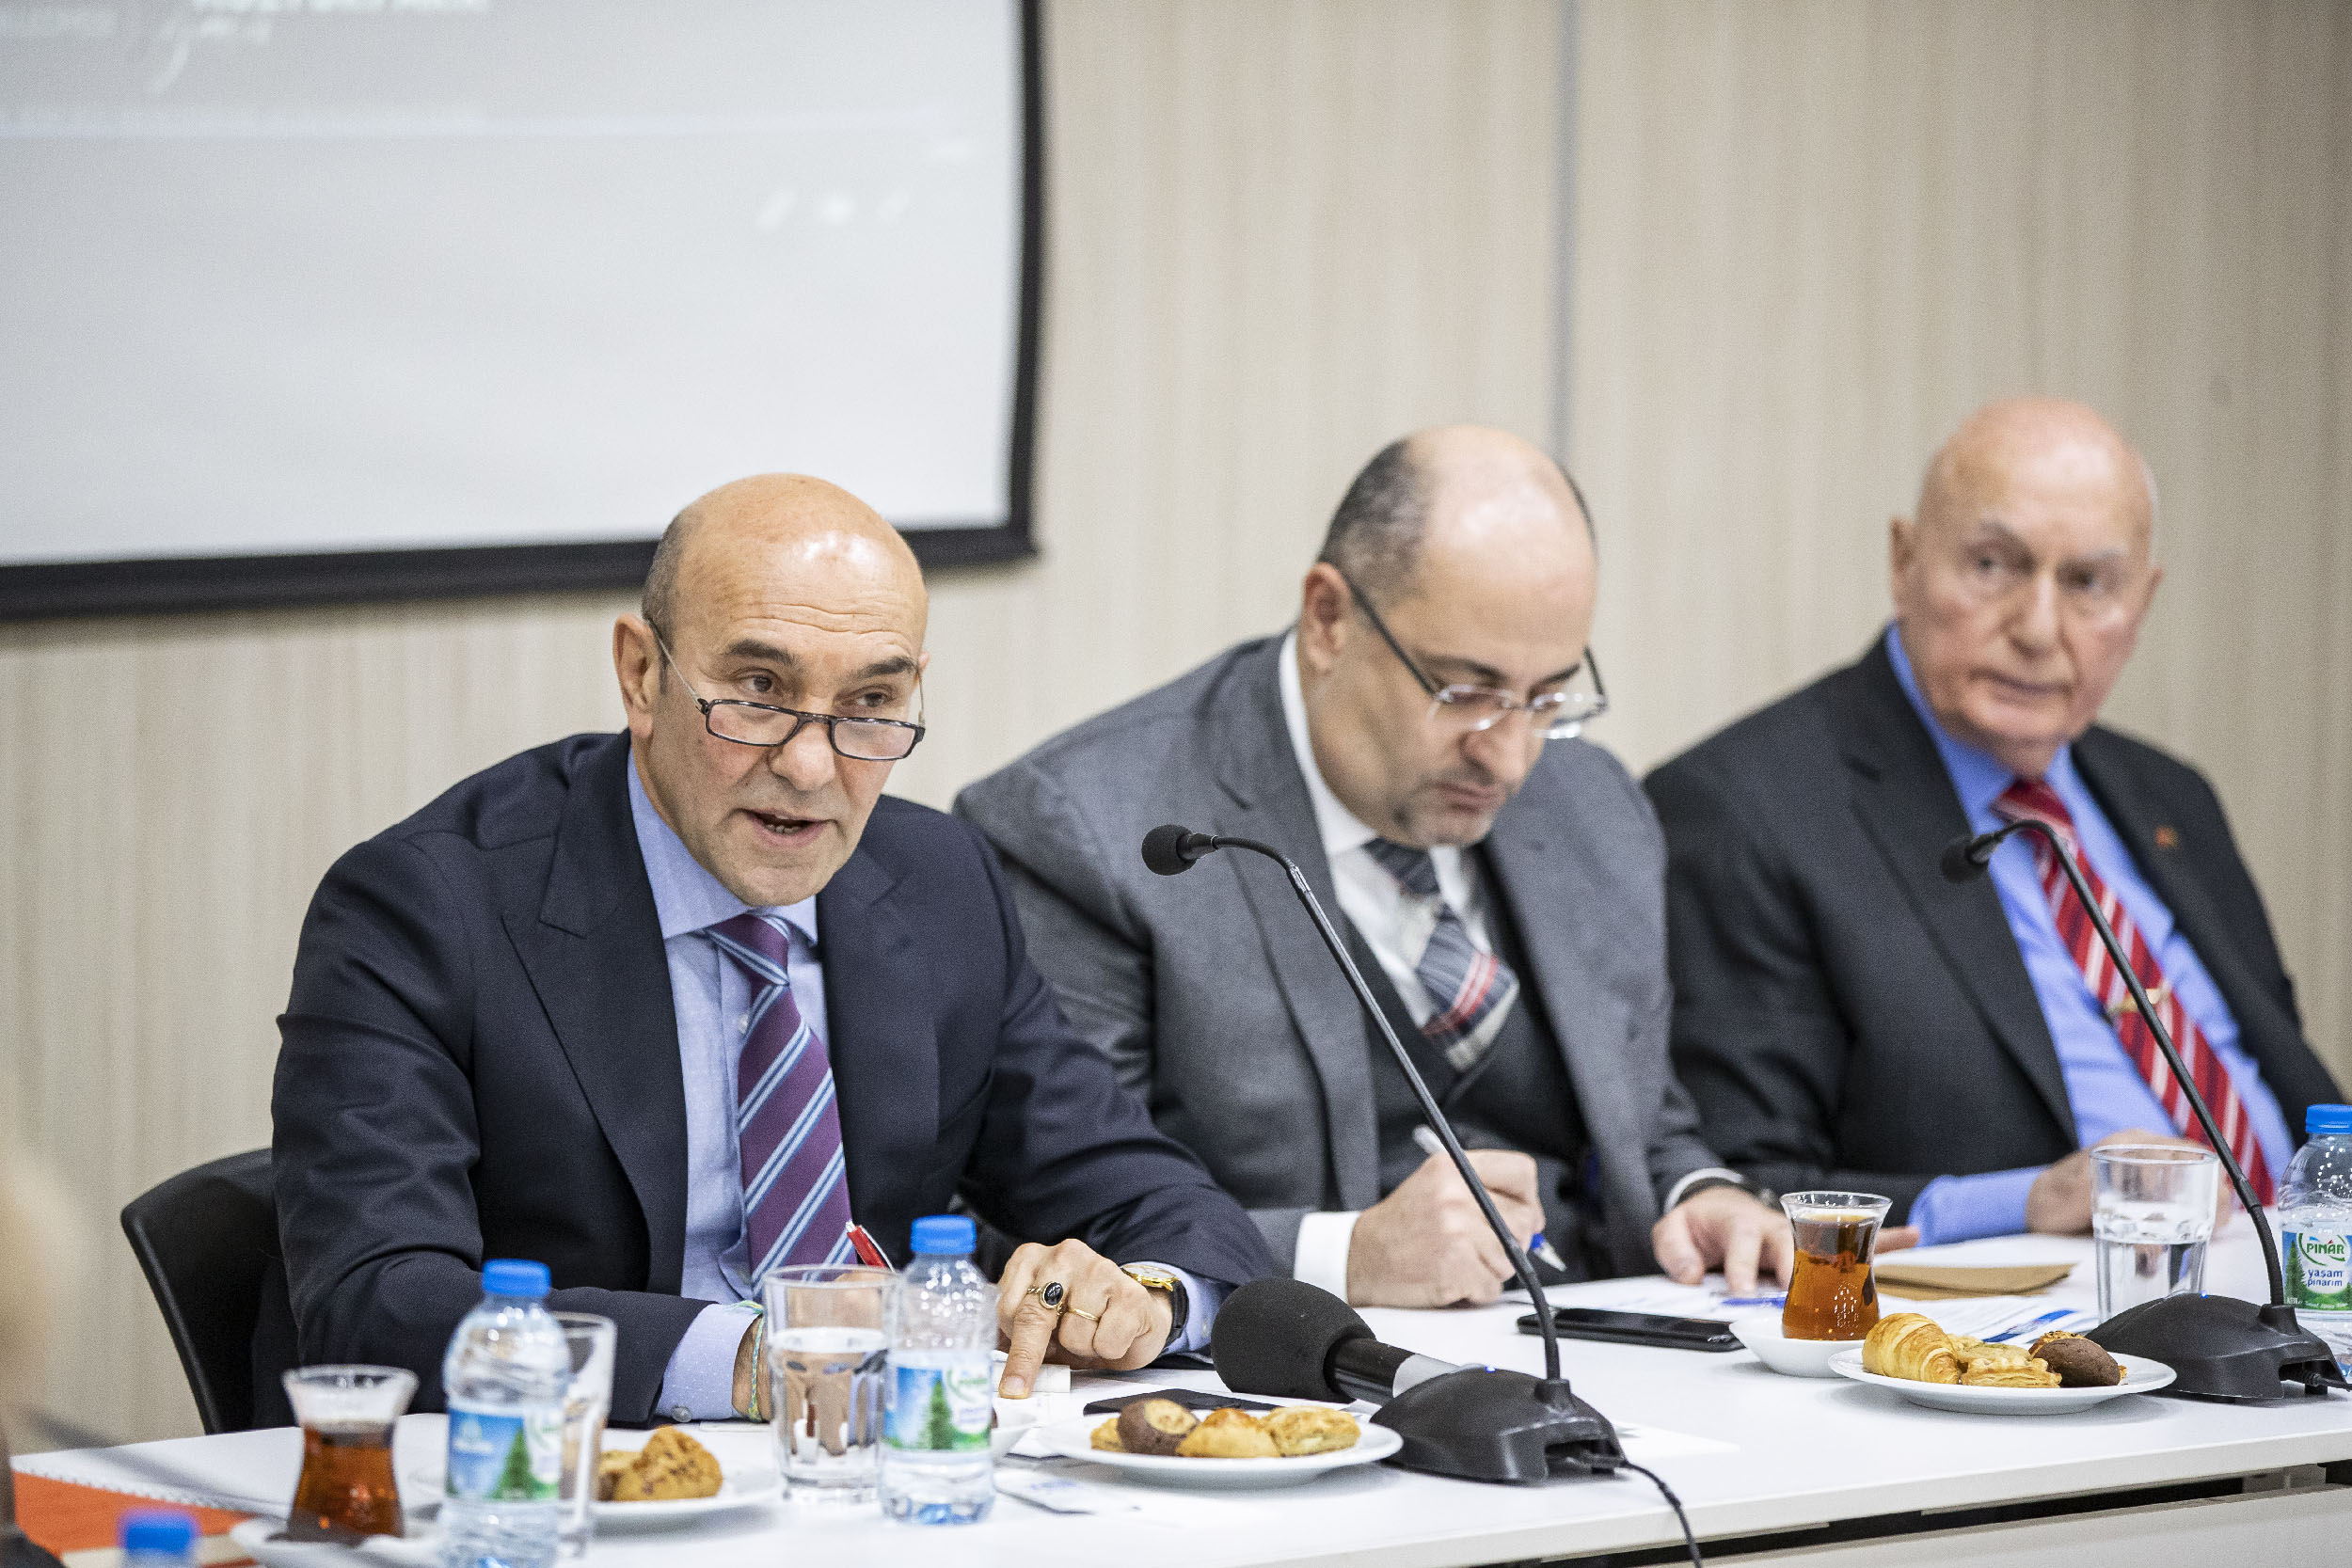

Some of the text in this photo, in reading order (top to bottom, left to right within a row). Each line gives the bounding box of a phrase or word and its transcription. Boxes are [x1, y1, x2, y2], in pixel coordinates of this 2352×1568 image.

[2307, 1243, 2344, 1254] PINAR
[2308, 1269, 2343, 1278] yaşam
[2307, 1278, 2343, 1287] pınarım
